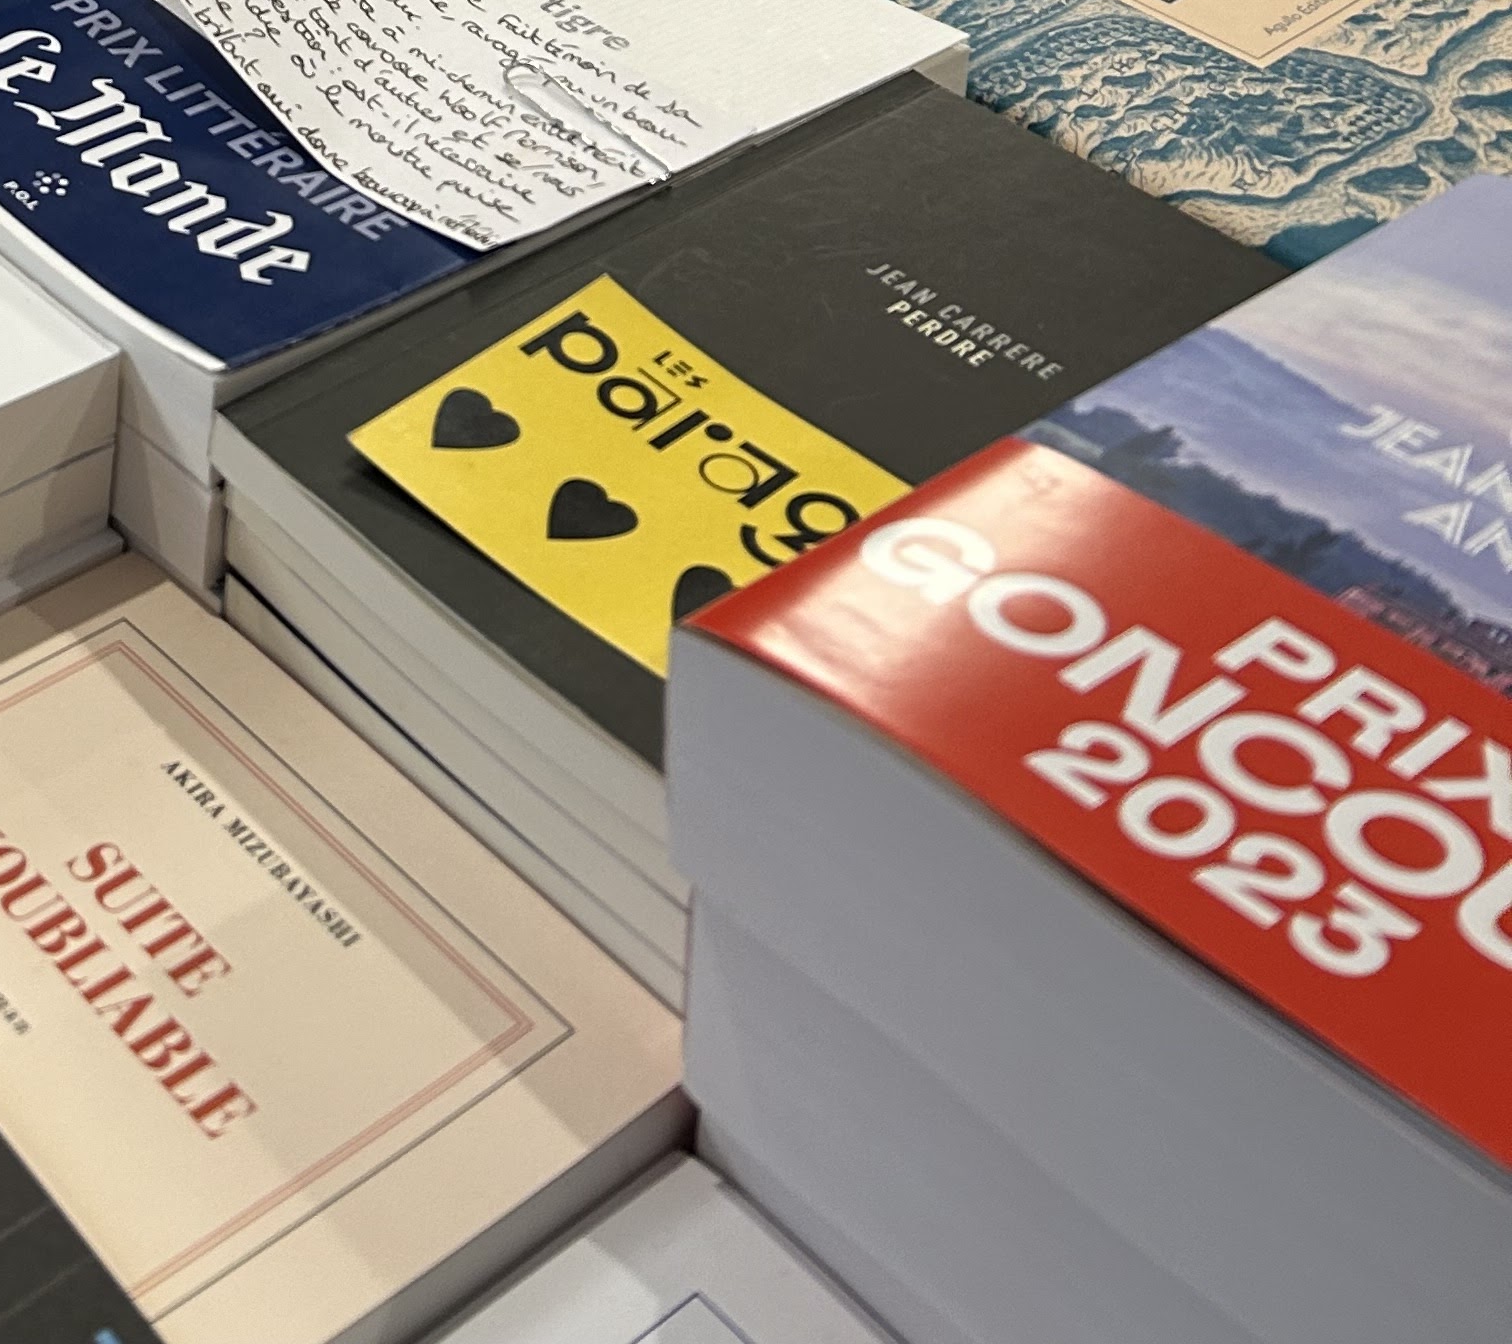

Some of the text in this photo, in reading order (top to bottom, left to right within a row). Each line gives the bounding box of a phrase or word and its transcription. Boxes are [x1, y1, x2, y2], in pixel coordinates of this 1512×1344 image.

[16, 62, 312, 288] Monde
[144, 64, 413, 244] LITTÉRAIRE
[865, 262, 934, 309] JEAN
[885, 299, 996, 371] PERDRE
[66, 837, 235, 999] SUITE
[158, 756, 362, 950] AKIRA MIZUBAYASHI
[1023, 723, 1423, 978] 2023
